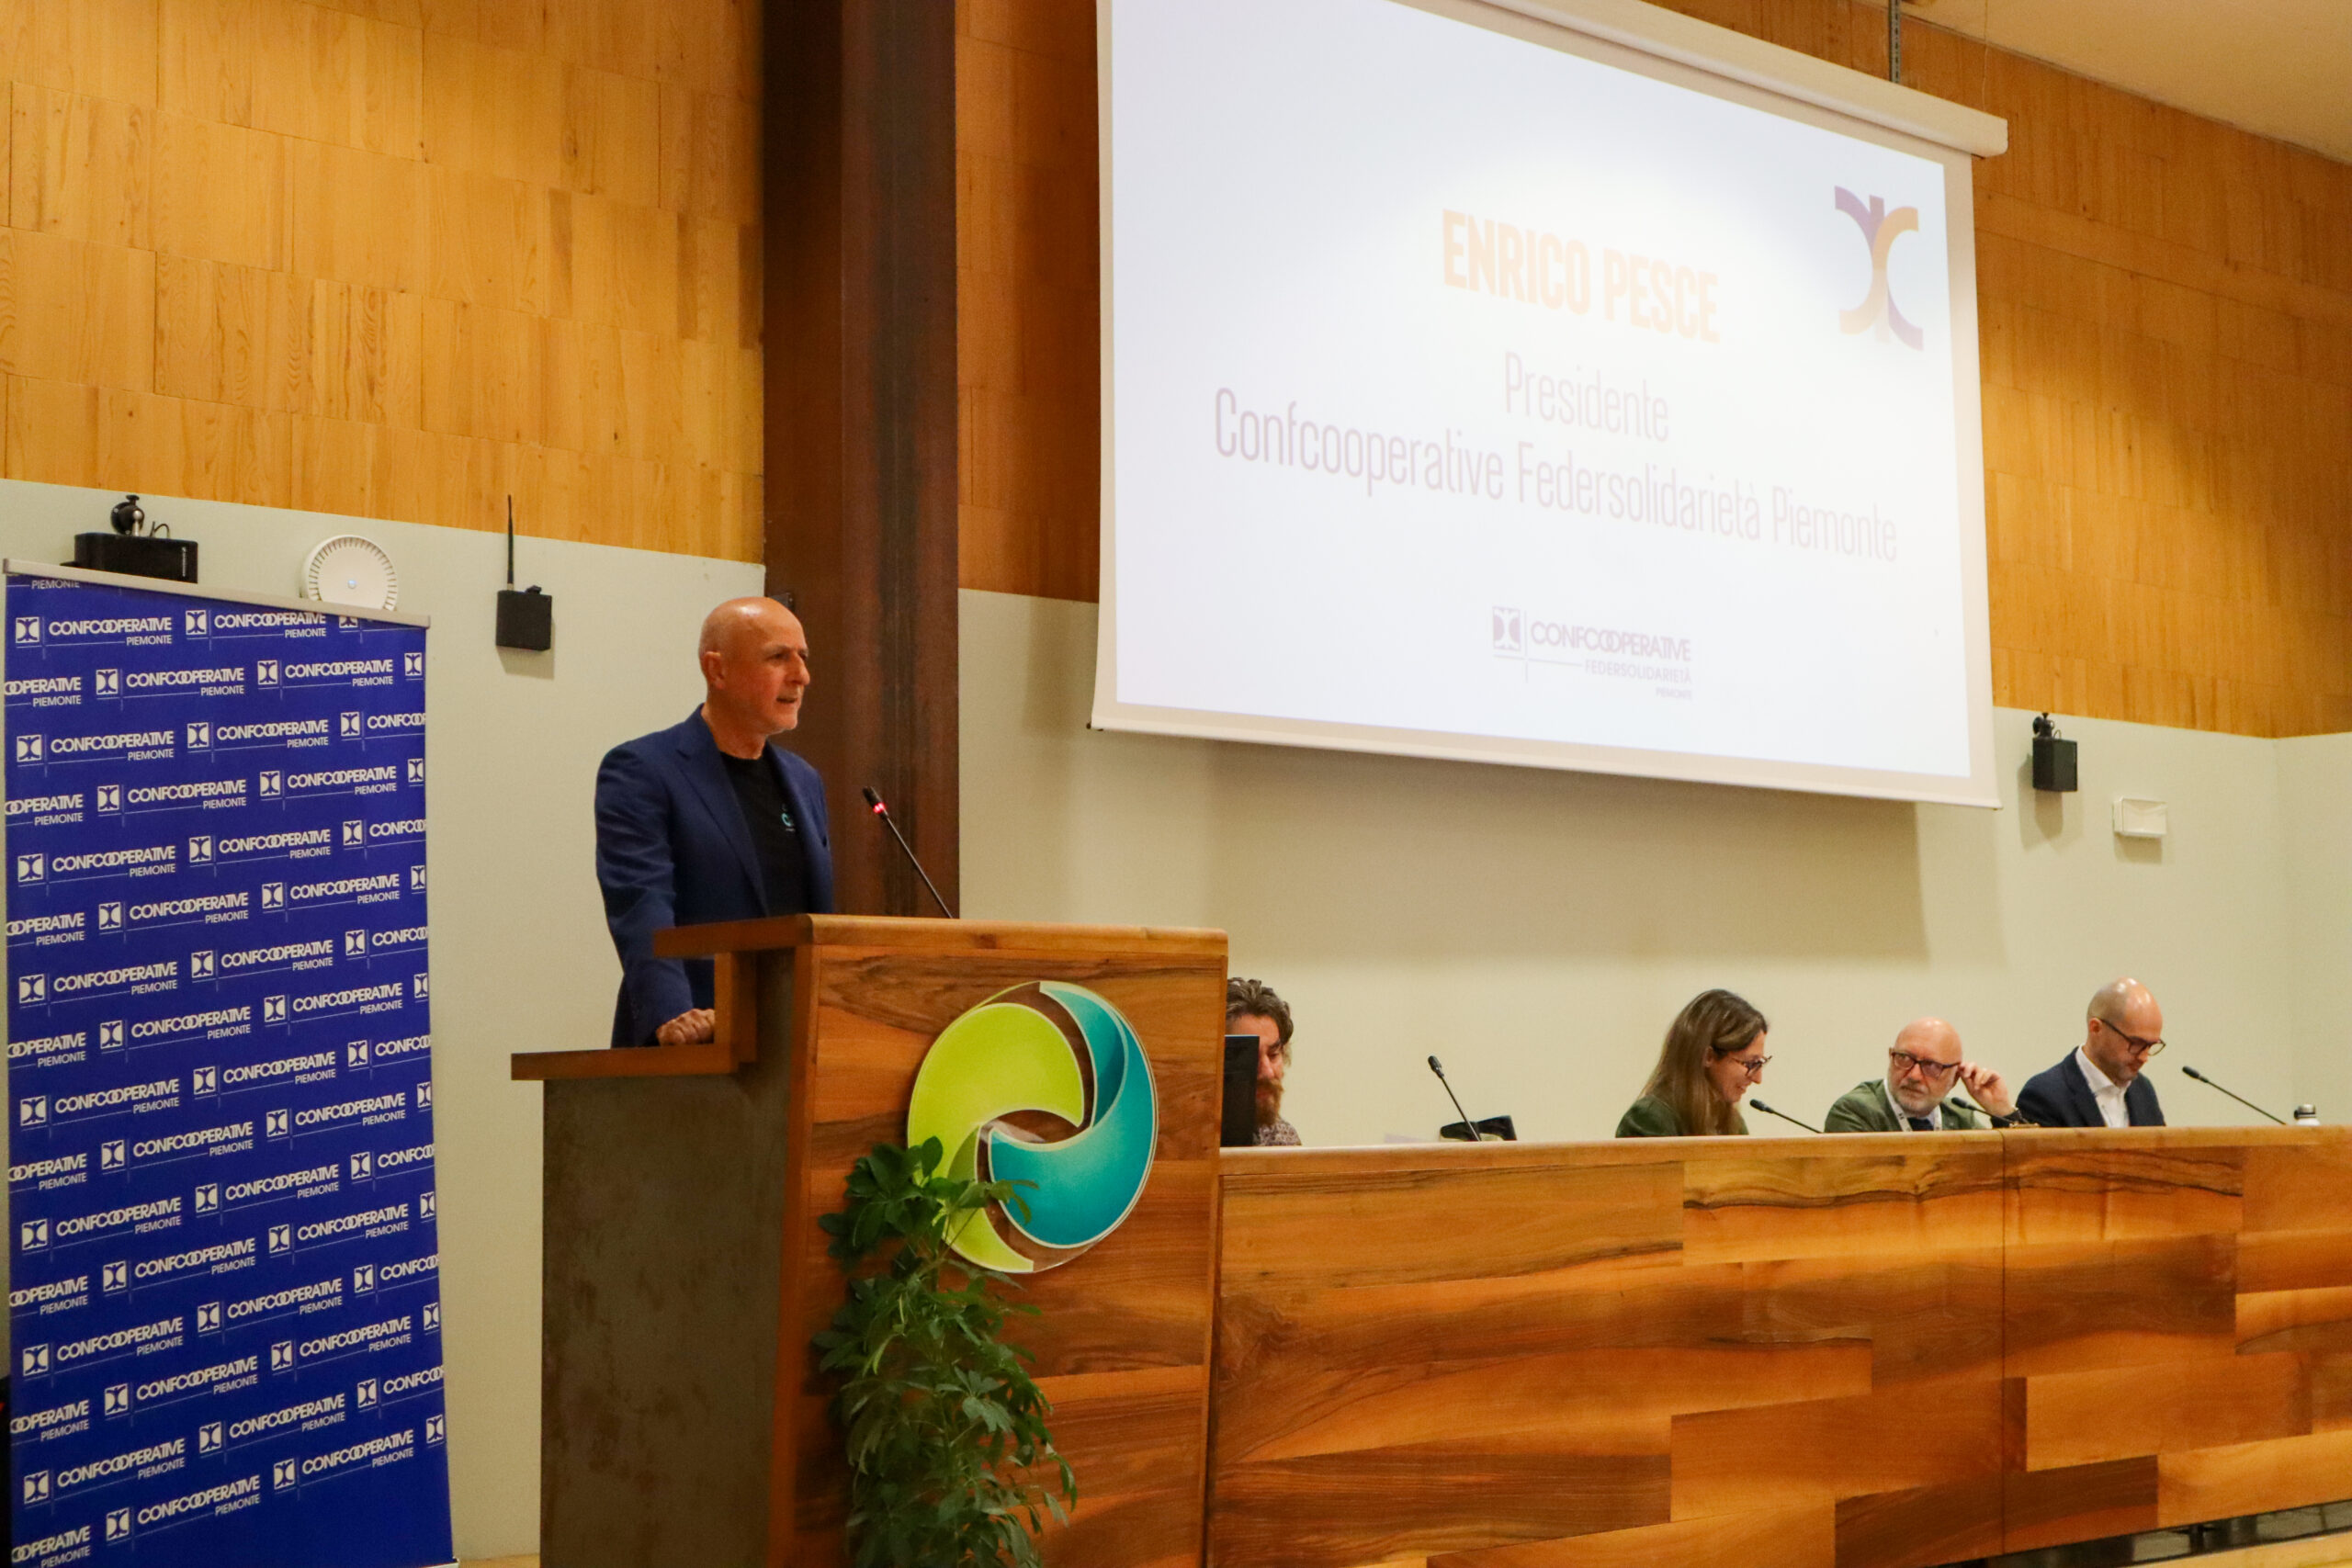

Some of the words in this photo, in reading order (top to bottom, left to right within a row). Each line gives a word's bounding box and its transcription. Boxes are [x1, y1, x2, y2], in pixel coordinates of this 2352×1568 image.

[1442, 209, 1590, 314] ENRICO
[1602, 248, 1719, 344] PESCE
[1504, 351, 1669, 443] Presidente
[1215, 387, 1503, 499] Confcooperative
[1517, 441, 1760, 542] Federsolidarietà
[1771, 485, 1897, 562] Piemonte
[32, 580, 80, 589] PIEMONTE
[49, 617, 172, 636] CONFCOOPERATIVE
[214, 612, 326, 628] CONFCOOPERATIVE
[127, 635, 172, 646] PIEMONTE
[285, 627, 326, 637] PIEMONTE
[1531, 620, 1691, 662] CONFCOOPERATIVE
[126, 668, 244, 687] CONFCOOPERATIVE
[285, 660, 393, 679] CONFCOOPERATIVE
[1585, 659, 1691, 683] FEDERSOLIDARIETÀ
[201, 685, 244, 696] PIEMONTE
[353, 676, 393, 686] PIEMONTE
[33, 695, 81, 707] PIEMONTE
[217, 719, 329, 740] CONFCOOPERATIVE
[51, 731, 174, 753] CONFCOOPERATIVE
[288, 737, 329, 748] PIEMONTE
[128, 749, 174, 761] PIEMONTE
[288, 766, 397, 789] CONFCOOPERATIVE
[128, 779, 246, 803] CONFCOOPERATIVE
[355, 783, 397, 795] PIEMONTE
[203, 797, 246, 809] PIEMONTE
[34, 812, 83, 826] PIEMONTE
[219, 829, 331, 853] CONFCOOPERATIVE
[52, 845, 175, 872] CONFCOOPERATIVE
[289, 846, 331, 859] PIEMONTE
[130, 863, 175, 877] PIEMONTE
[290, 874, 400, 900] CONFCOOPERATIVE
[357, 890, 400, 904] PIEMONTE
[130, 892, 248, 919] CONFCOOPERATIVE
[205, 910, 248, 923] PIEMONTE
[36, 931, 85, 946] PIEMONTE
[221, 940, 333, 968] CONFCOOPERATIVE
[292, 957, 333, 971] PIEMONTE
[53, 962, 177, 992] CONFCOOPERATIVE
[131, 979, 177, 995] PIEMONTE
[293, 983, 402, 1012] CONFCOOPERATIVE
[360, 999, 402, 1014] PIEMONTE
[131, 1006, 251, 1038] CONFCOOPERATIVE
[208, 1024, 251, 1040] PIEMONTE
[38, 1051, 85, 1067] PIEMONTE
[223, 1051, 335, 1083] CONFCOOPERATIVE
[295, 1068, 335, 1084] PIEMONTE
[55, 1078, 179, 1113] CONFCOOPERATIVE
[133, 1097, 179, 1113] PIEMONTE
[295, 1092, 405, 1125] CONFCOOPERATIVE
[363, 1110, 405, 1126] PIEMONTE
[133, 1122, 253, 1157] CONFCOOPERATIVE
[209, 1139, 253, 1156] PIEMONTE
[39, 1172, 87, 1190] PIEMONTE
[225, 1164, 339, 1201] CONFCOOPERATIVE
[298, 1181, 339, 1199] PIEMONTE
[56, 1197, 181, 1236] CONFCOOPERATIVE
[135, 1215, 181, 1234] PIEMONTE
[298, 1203, 409, 1240] CONFCOOPERATIVE
[366, 1221, 409, 1238] PIEMONTE
[135, 1237, 255, 1278] CONFCOOPERATIVE
[211, 1256, 255, 1275] PIEMONTE
[40, 1295, 88, 1314] PIEMONTE
[227, 1278, 342, 1318] CONFCOOPERATIVE
[300, 1296, 342, 1314] PIEMONTE
[57, 1316, 183, 1361] CONFCOOPERATIVE
[137, 1336, 183, 1356] PIEMONTE
[300, 1315, 411, 1357] CONFCOOPERATIVE
[368, 1333, 411, 1352] PIEMONTE
[136, 1356, 257, 1400] CONFCOOPERATIVE
[213, 1374, 257, 1394] PIEMONTE
[229, 1393, 345, 1438] CONFCOOPERATIVE
[301, 1412, 345, 1432] PIEMONTE
[40, 1419, 89, 1441] PIEMONTE
[302, 1429, 413, 1474] CONFCOOPERATIVE
[372, 1447, 413, 1468] PIEMONTE
[57, 1438, 185, 1487] CONFCOOPERATIVE
[138, 1457, 185, 1479] PIEMONTE
[138, 1474, 260, 1524] CONFCOOPERATIVE
[215, 1494, 260, 1516] PIEMONTE
[41, 1546, 90, 1568] PIEMONTE
